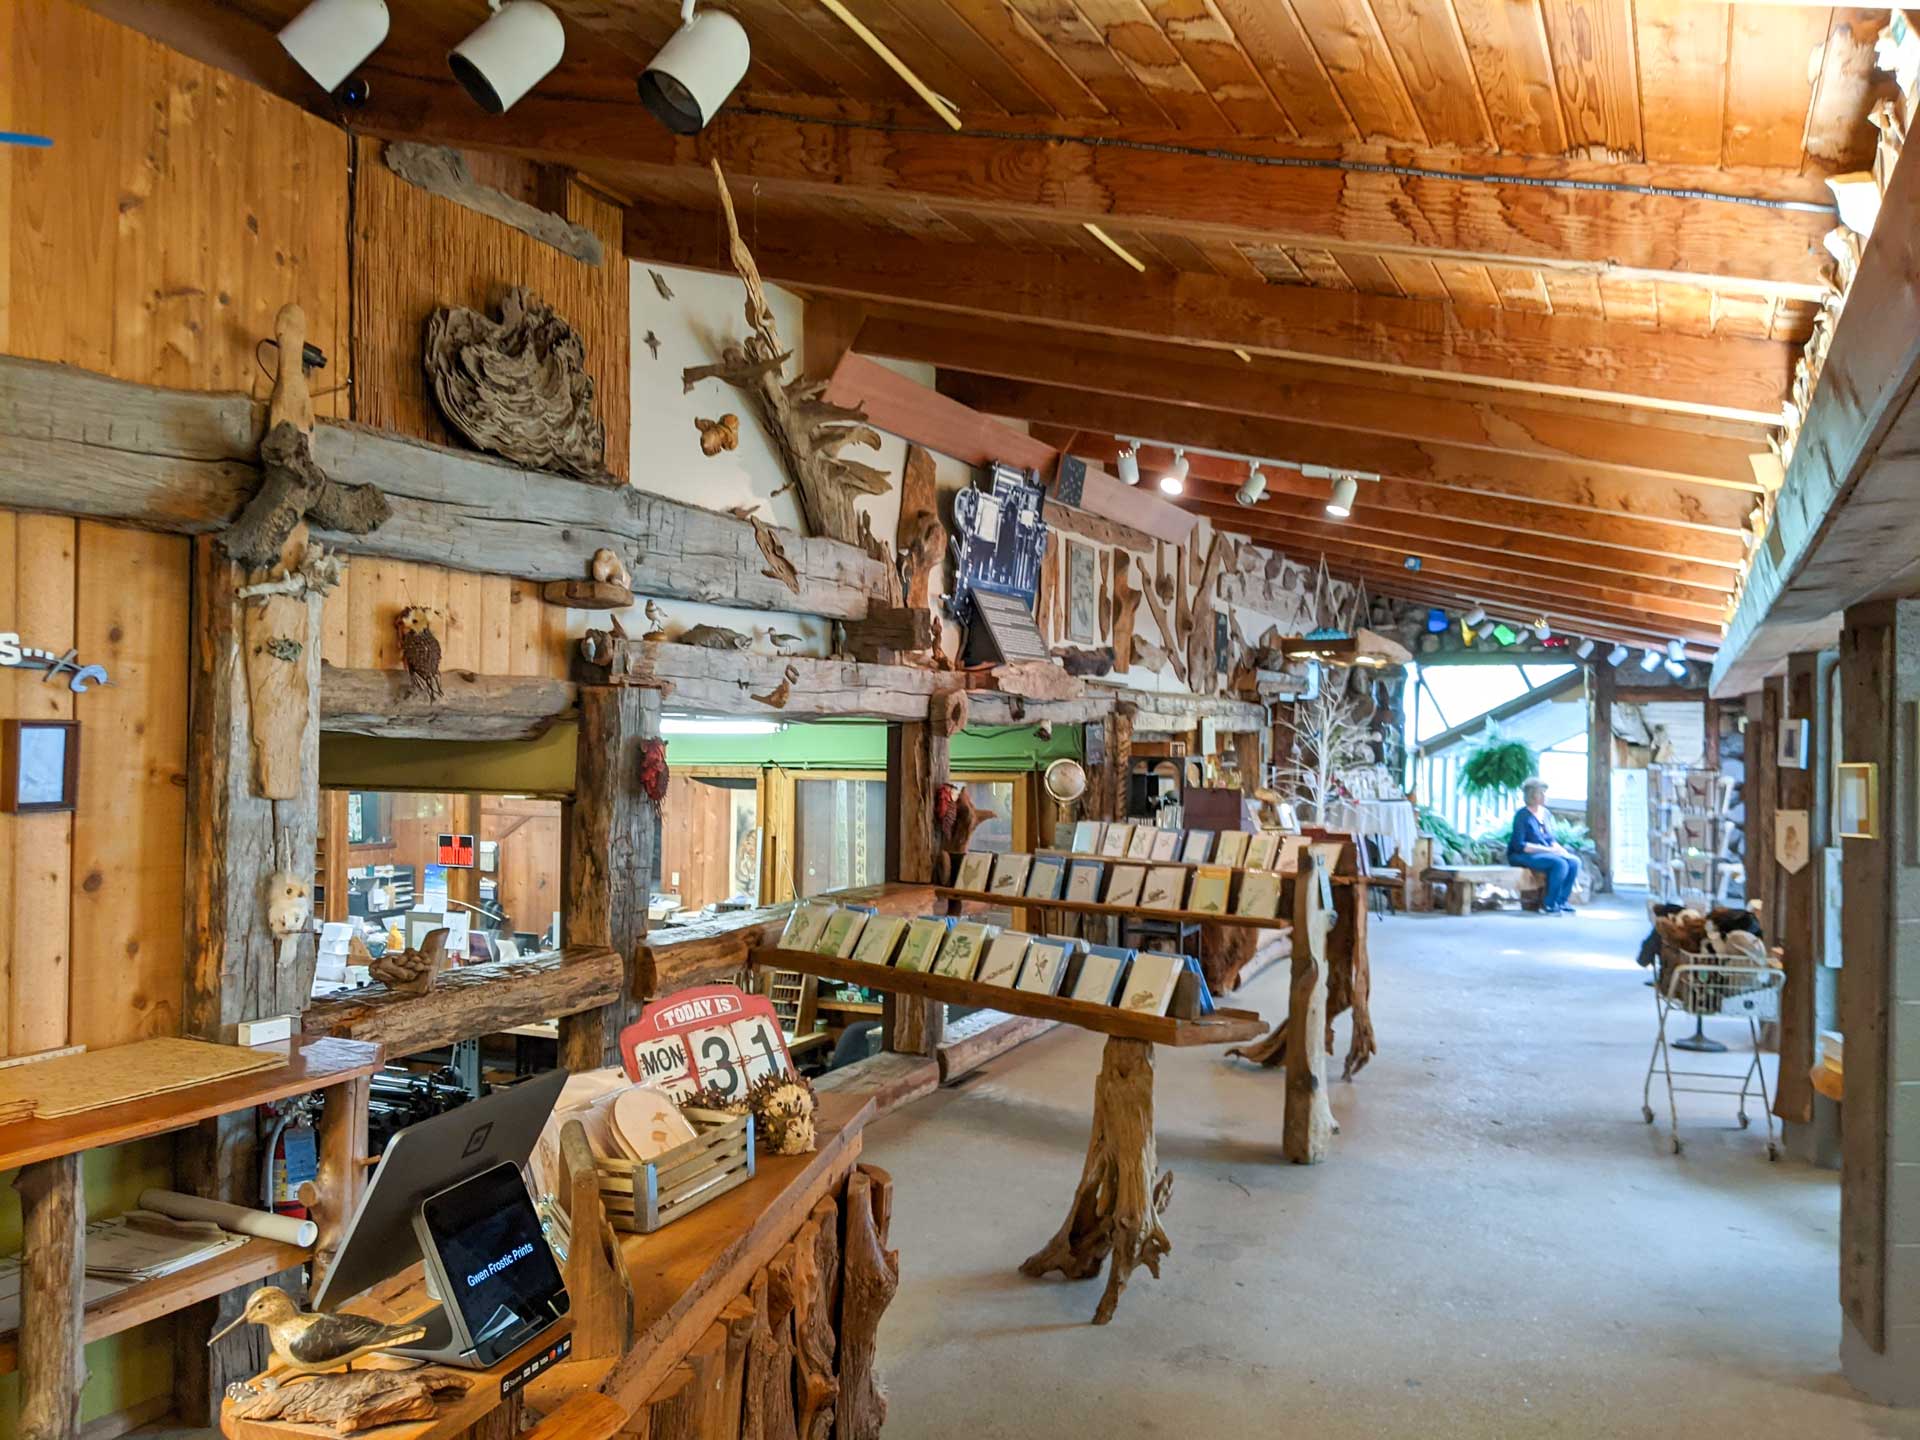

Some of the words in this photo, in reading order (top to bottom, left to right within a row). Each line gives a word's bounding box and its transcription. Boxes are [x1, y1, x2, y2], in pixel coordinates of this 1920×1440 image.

[663, 999, 712, 1026] TODAY
[713, 998, 732, 1013] IS
[640, 1043, 685, 1076] MON
[467, 1269, 490, 1287] Gwen
[488, 1254, 514, 1276] Frostic
[512, 1243, 534, 1261] Prints
